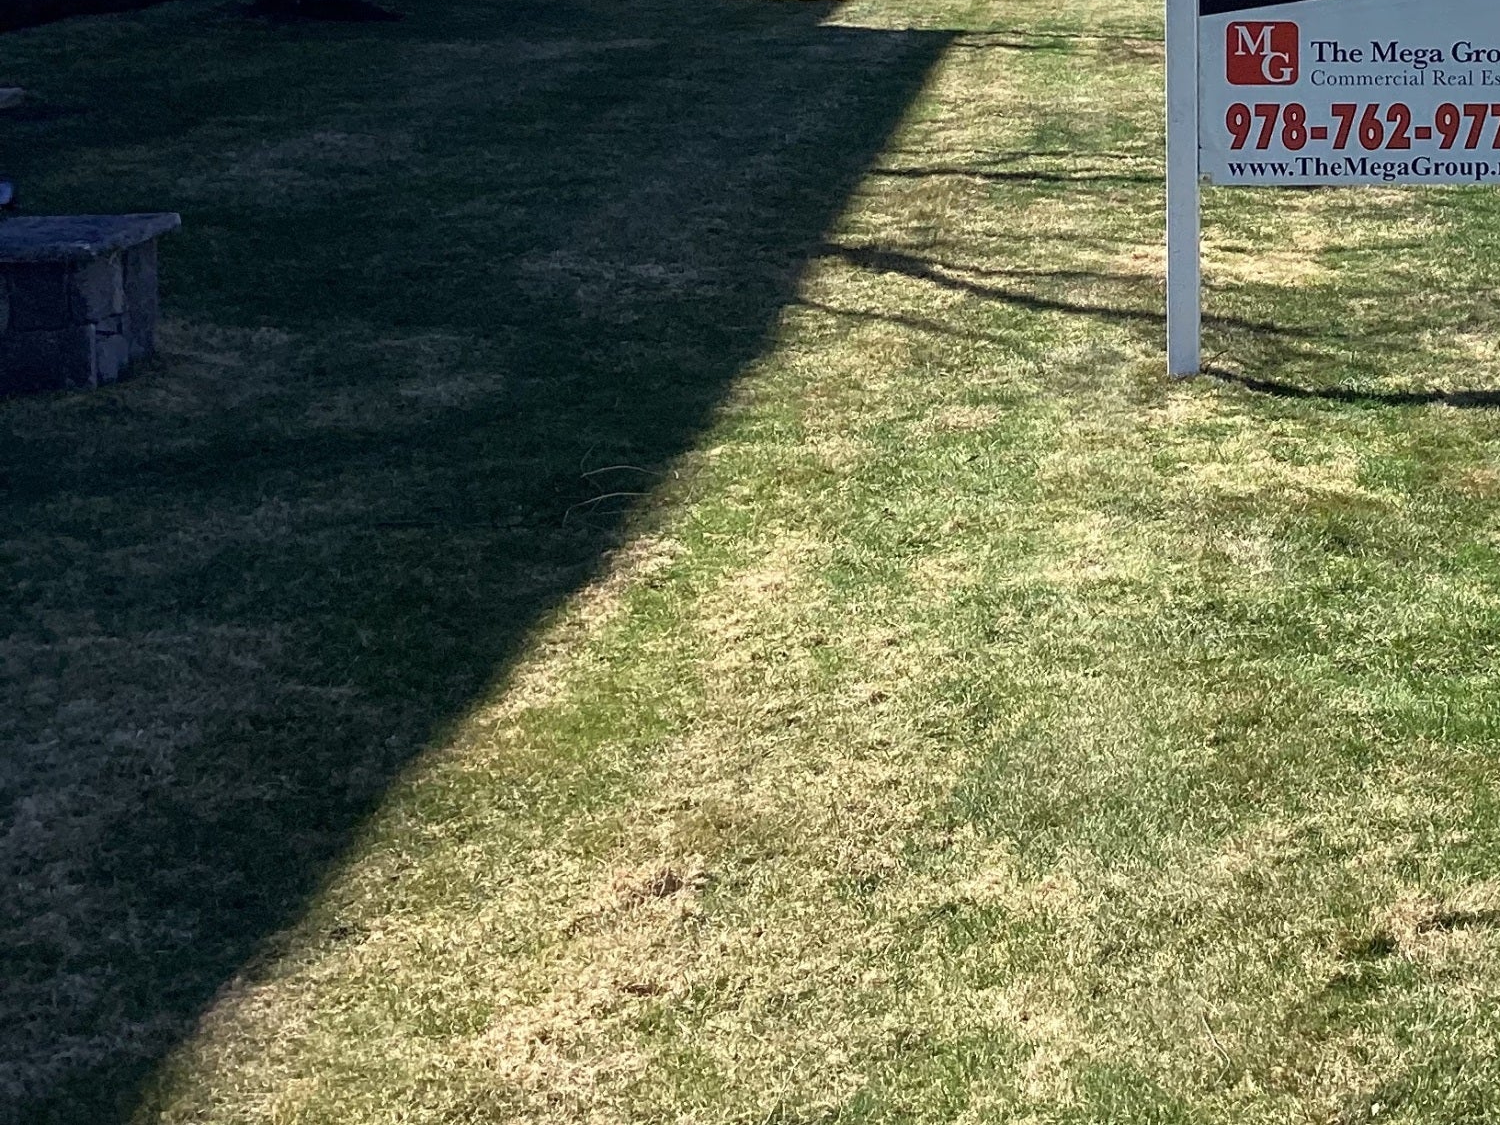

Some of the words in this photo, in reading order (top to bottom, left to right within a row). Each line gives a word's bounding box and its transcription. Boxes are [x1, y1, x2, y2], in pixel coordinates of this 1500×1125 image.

[1310, 41, 1363, 63] The
[1370, 41, 1445, 69] Mega
[1310, 70, 1425, 86] Commercial
[1432, 70, 1473, 86] Real
